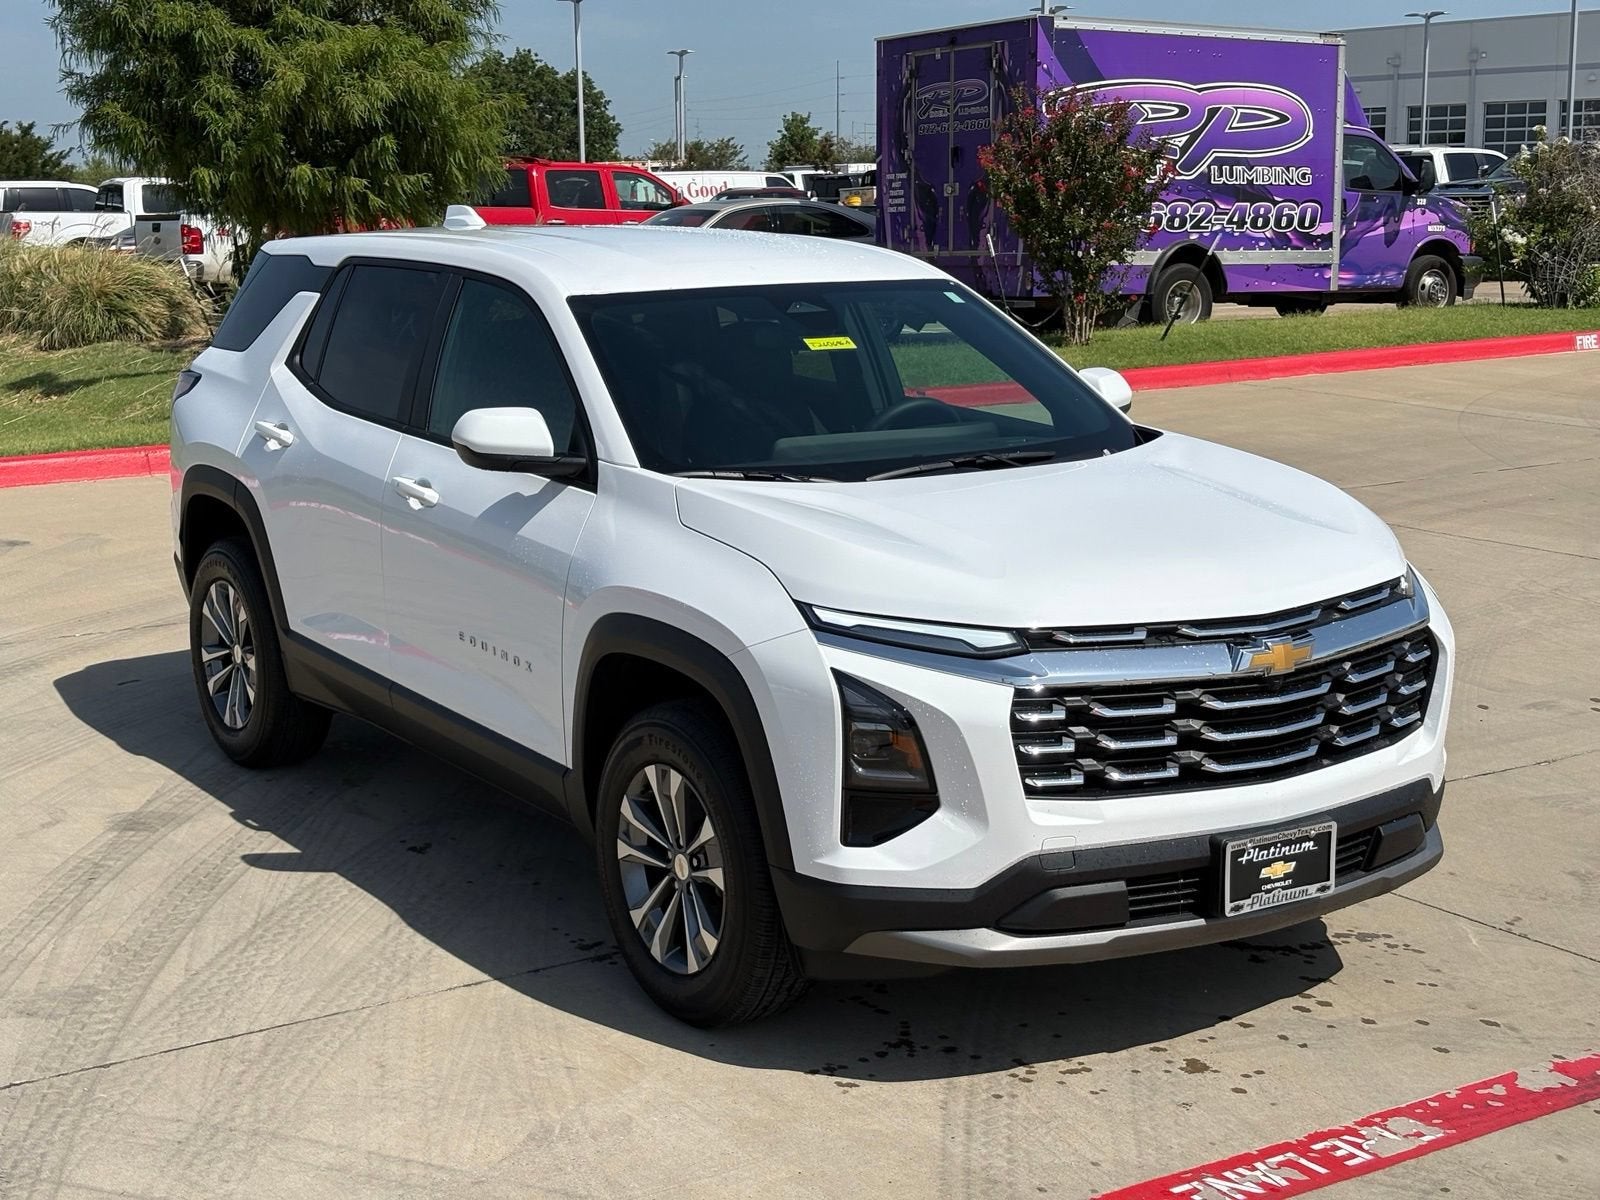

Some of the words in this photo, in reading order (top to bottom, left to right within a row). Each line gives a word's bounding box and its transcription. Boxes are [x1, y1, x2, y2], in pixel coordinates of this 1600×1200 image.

[1211, 165, 1312, 186] LUMBING
[687, 179, 728, 198] Good
[1575, 334, 1599, 350] FIRE
[458, 630, 534, 673] EQUINOX
[646, 733, 703, 780] Firestone
[1238, 841, 1318, 864] Platinum
[1261, 879, 1293, 891] CHEVROLET
[1247, 888, 1313, 909] Platinum
